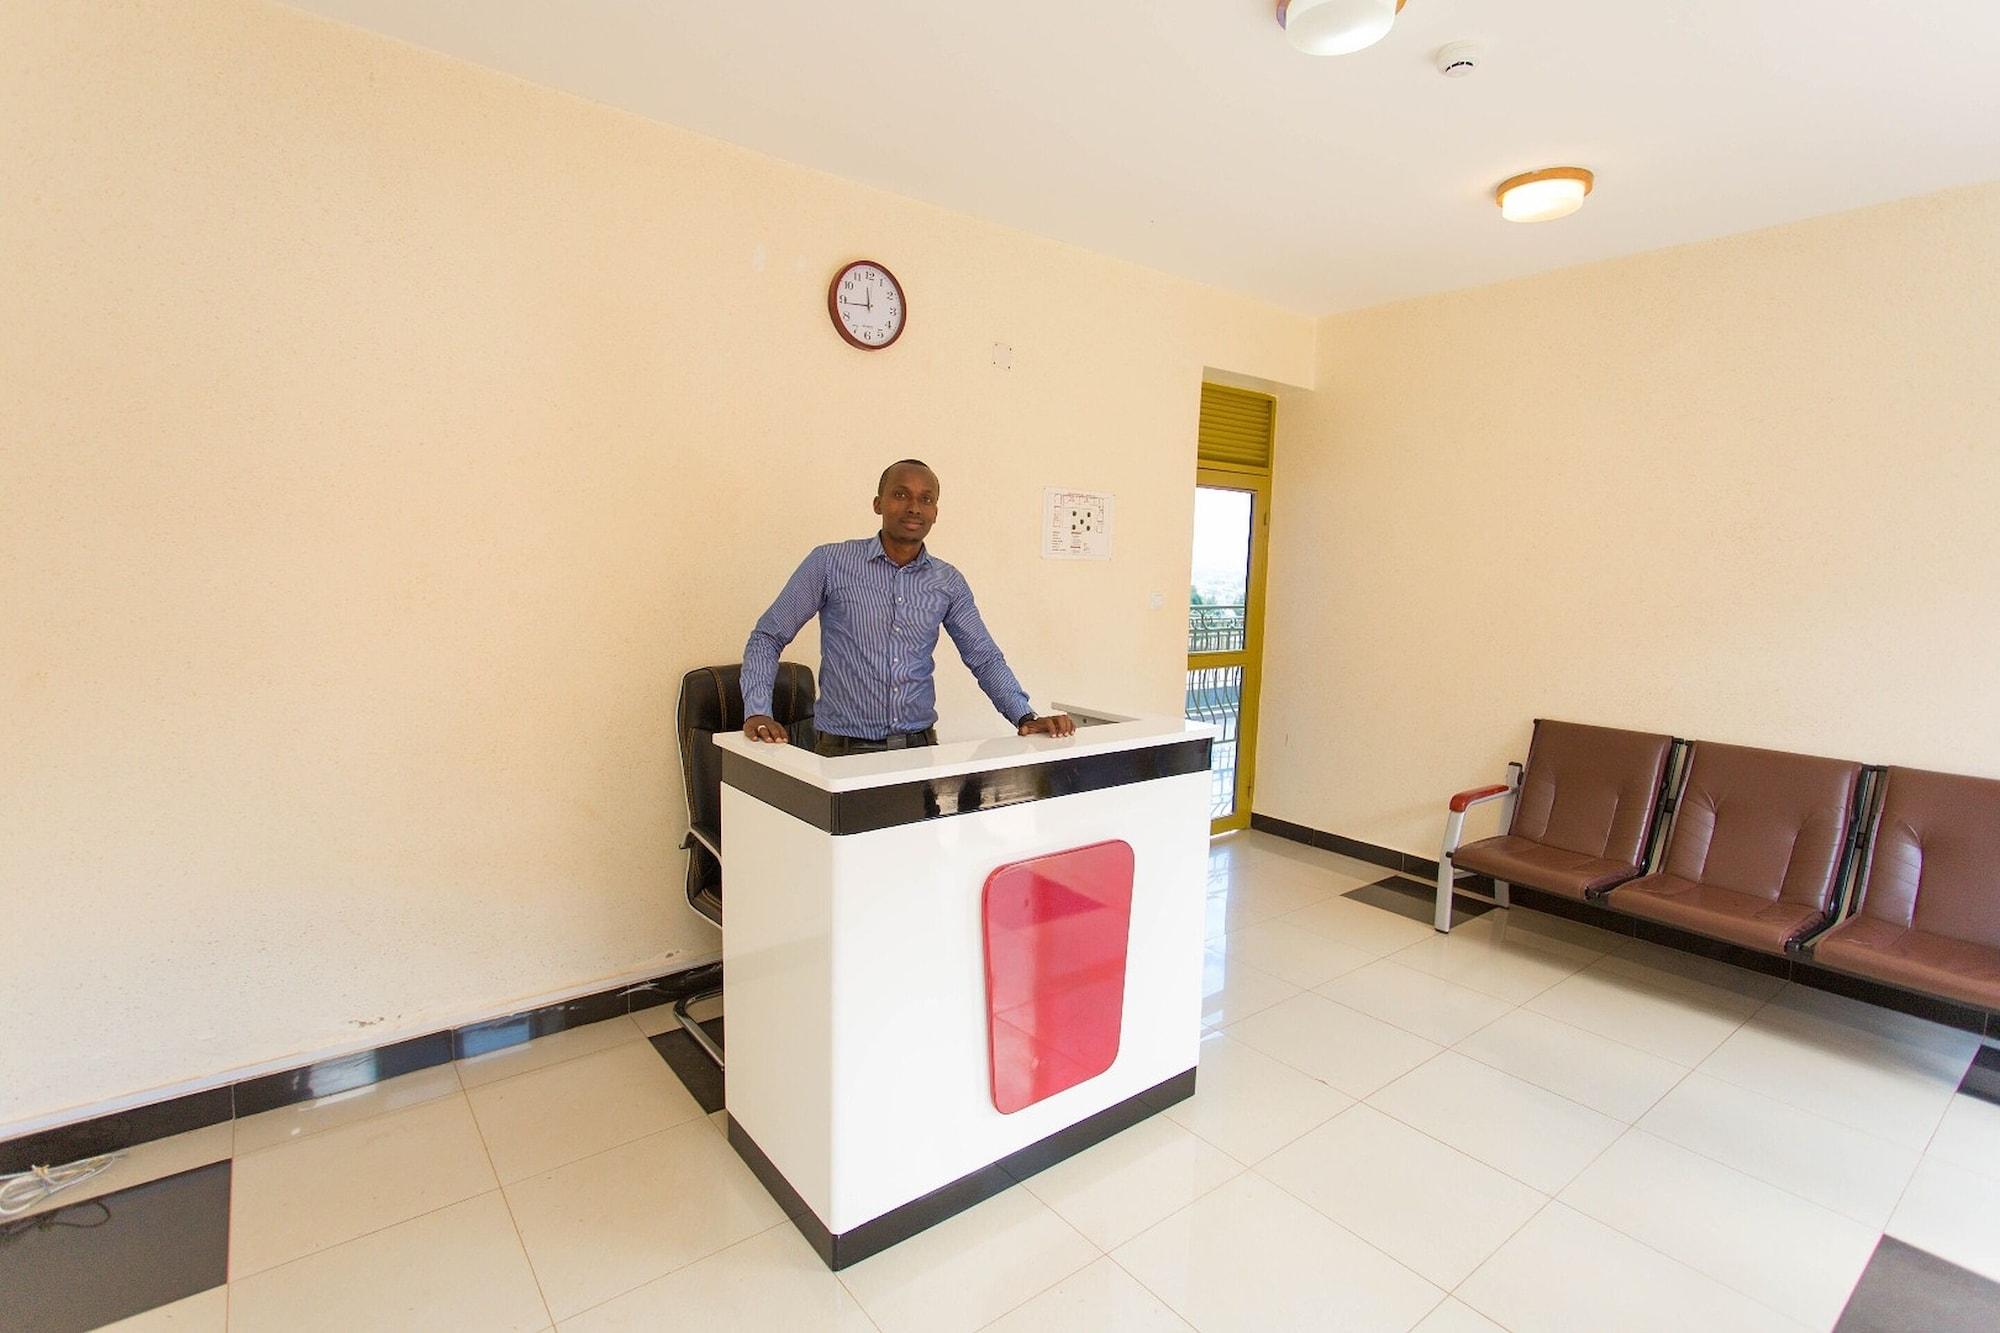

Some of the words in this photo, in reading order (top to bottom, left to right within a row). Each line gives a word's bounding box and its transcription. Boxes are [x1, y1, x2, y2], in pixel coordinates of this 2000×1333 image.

[854, 272, 861, 281] 11
[865, 271, 875, 281] 12
[844, 281, 854, 290] 10
[879, 278, 883, 287] 1
[839, 294, 847, 304] 9
[886, 291, 894, 300] 2
[843, 311, 850, 320] 8
[889, 307, 897, 316] 3
[852, 324, 859, 333] 7
[885, 320, 892, 329] 4
[863, 331, 871, 340] 6
[877, 328, 884, 338] 5
